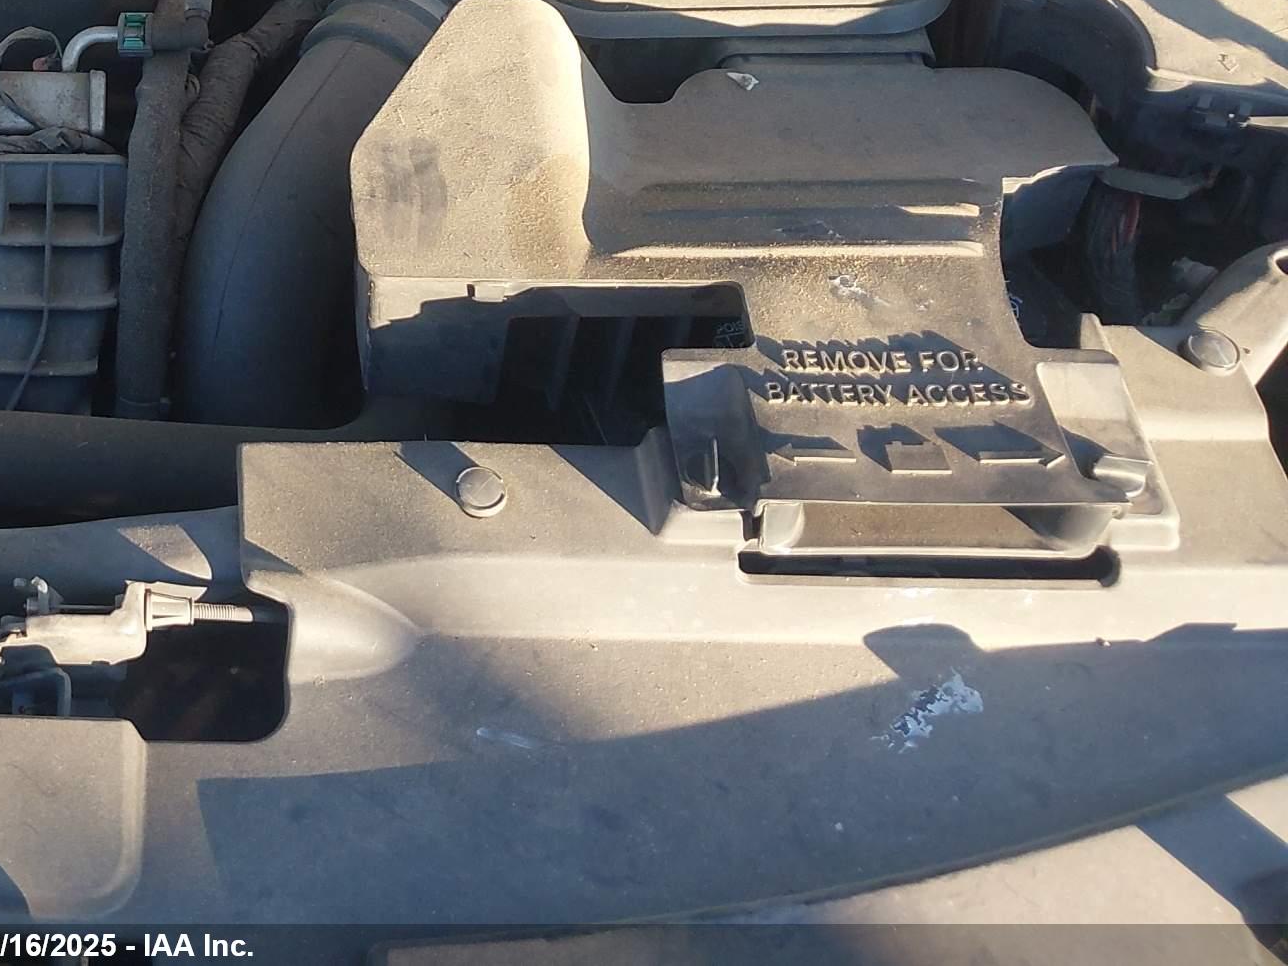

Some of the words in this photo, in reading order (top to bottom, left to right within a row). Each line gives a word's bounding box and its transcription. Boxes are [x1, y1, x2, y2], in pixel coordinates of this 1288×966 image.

[780, 349, 912, 373] REMOVE
[918, 350, 984, 373] FOR
[765, 381, 894, 407] BATTERY
[905, 381, 1033, 408] ACCESS
